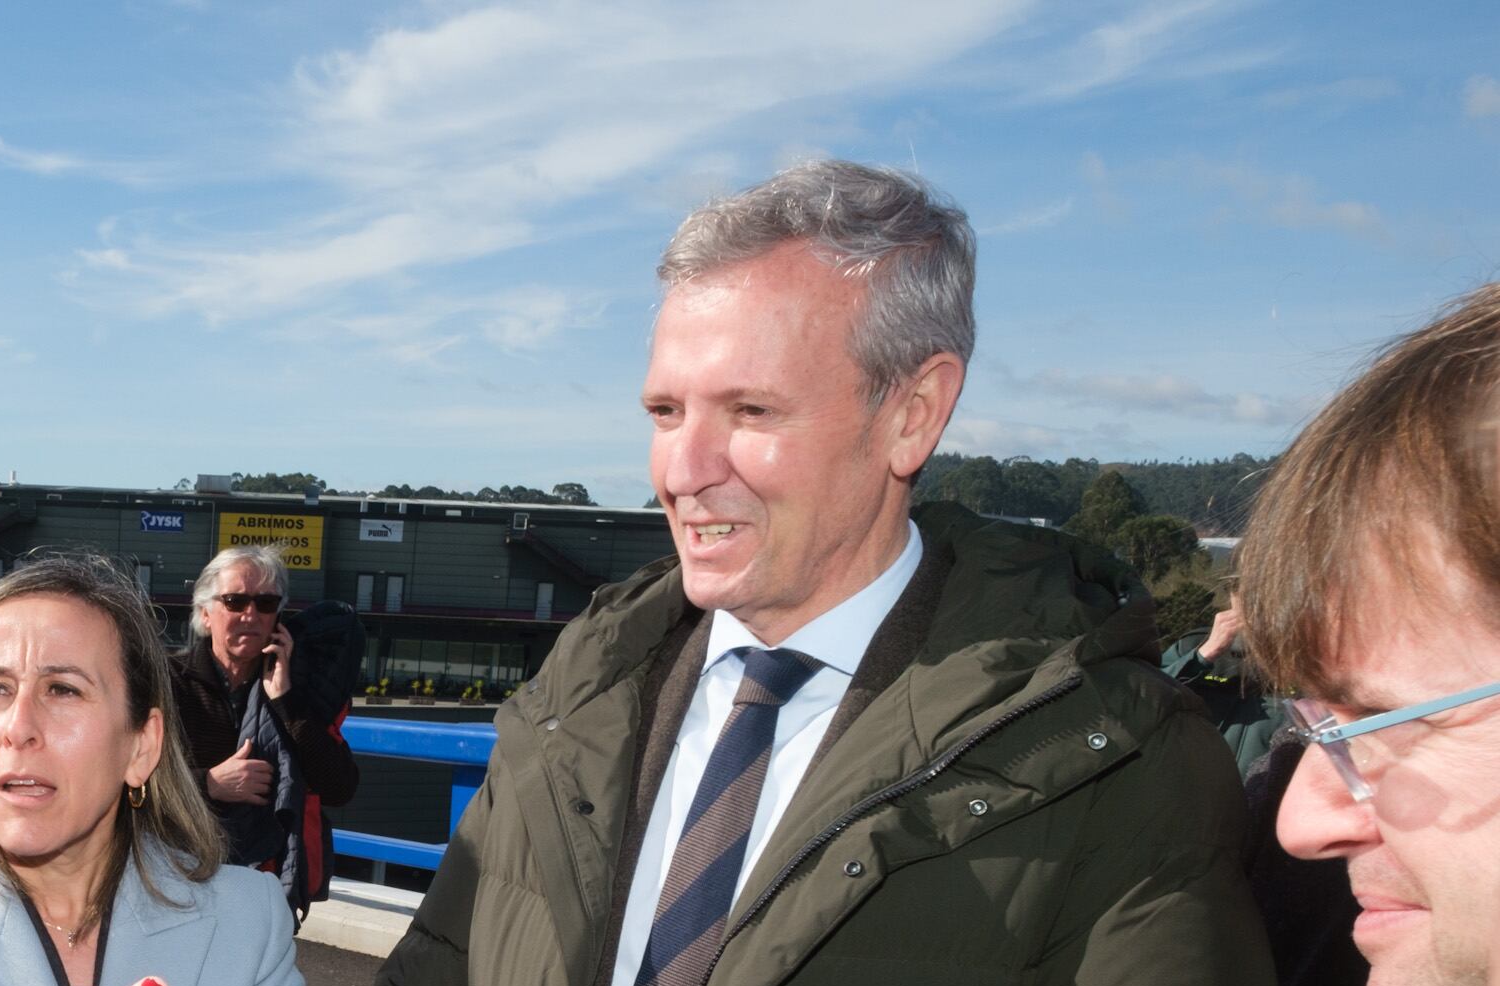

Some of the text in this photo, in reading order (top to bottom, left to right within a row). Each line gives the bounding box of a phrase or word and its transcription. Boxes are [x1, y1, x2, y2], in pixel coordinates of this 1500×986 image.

[149, 515, 182, 528] JYSK
[237, 516, 304, 529] ABRIMOS
[231, 534, 309, 548] DOMINGOS
[281, 554, 312, 566] VOS
